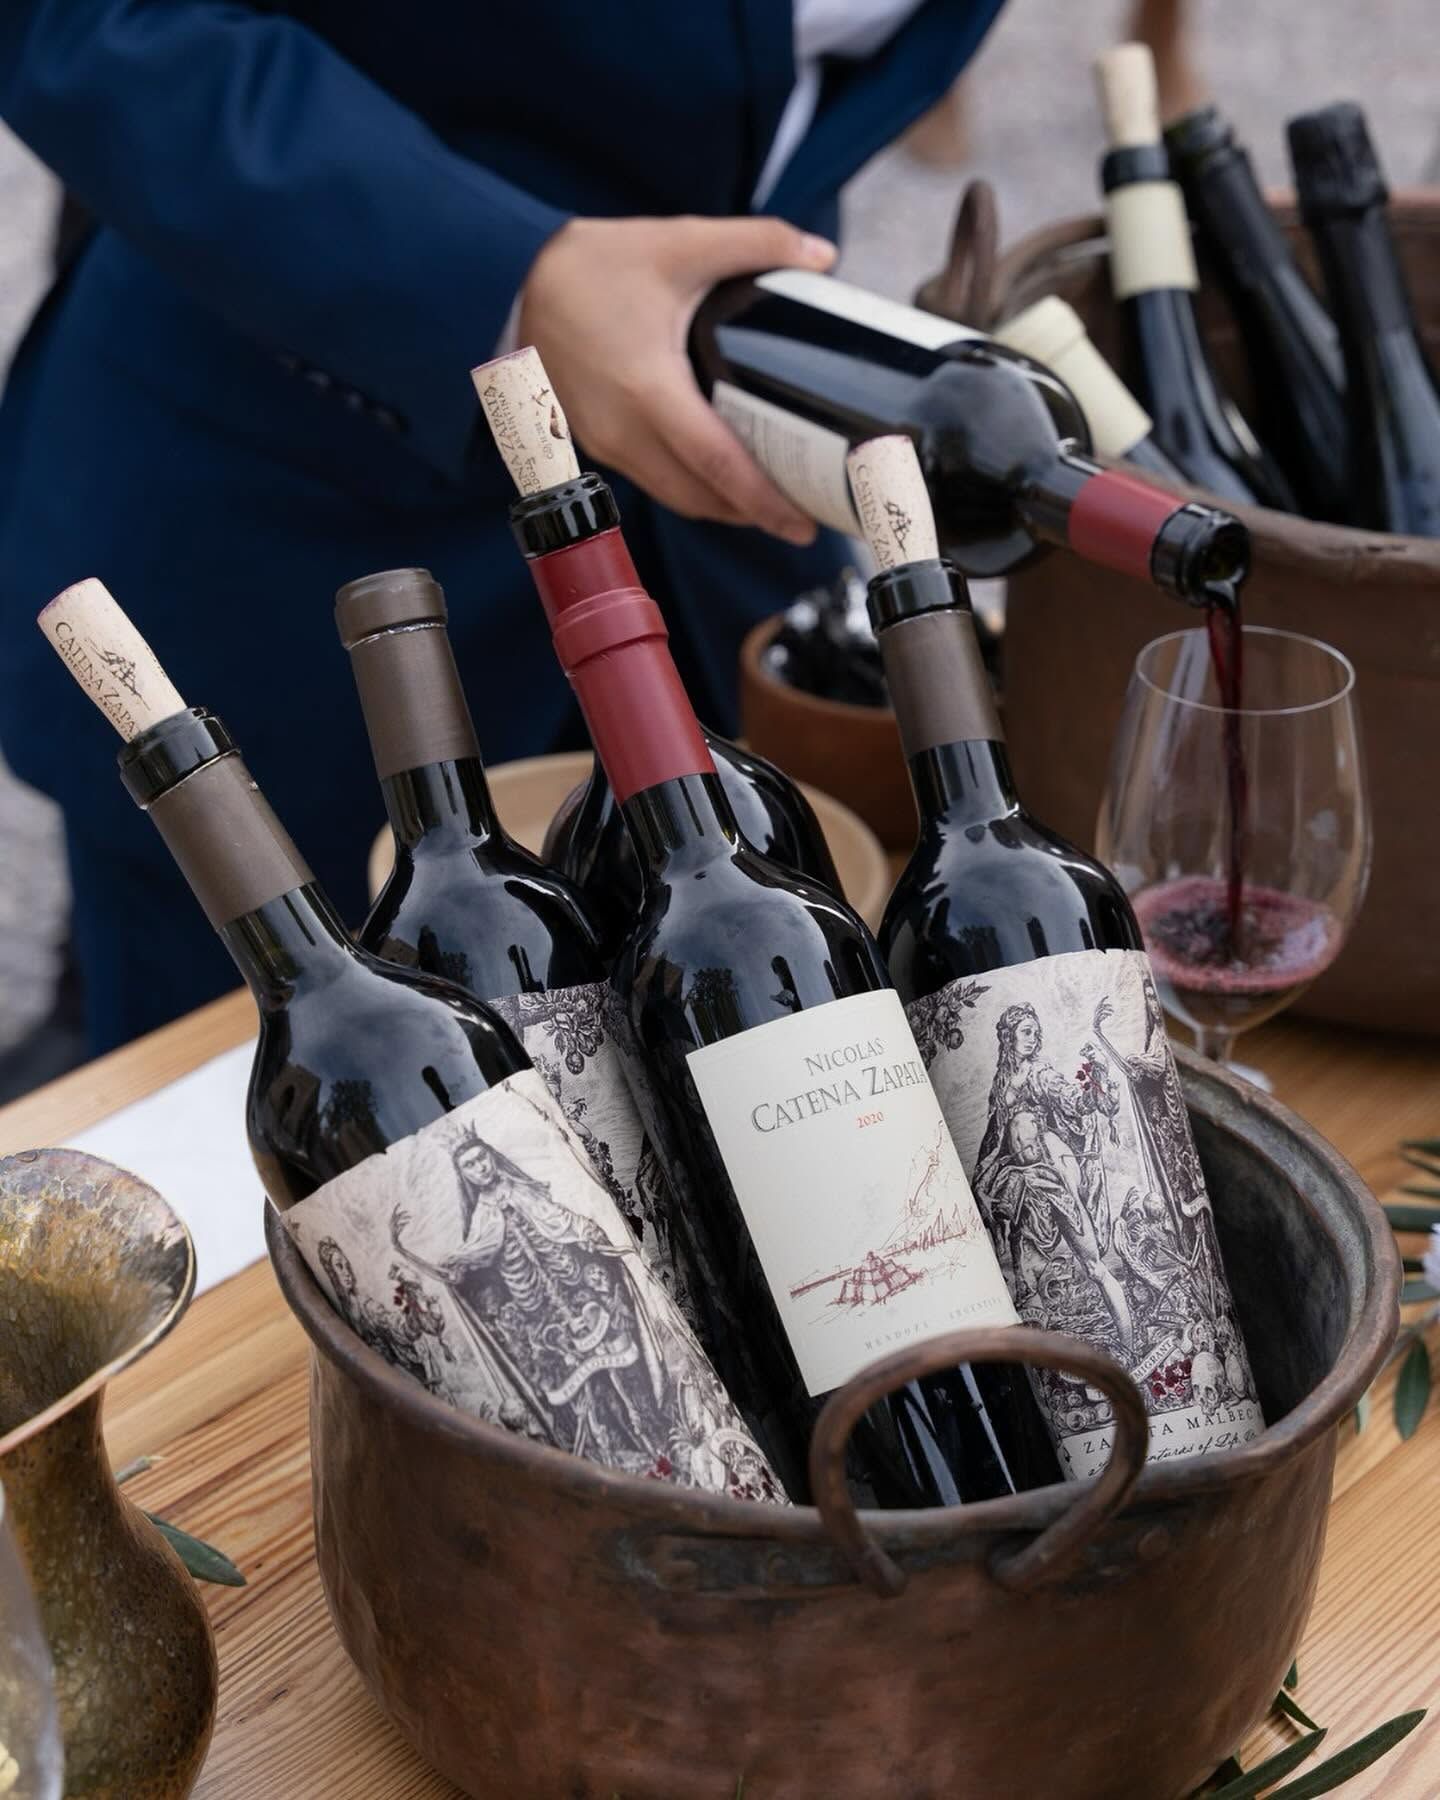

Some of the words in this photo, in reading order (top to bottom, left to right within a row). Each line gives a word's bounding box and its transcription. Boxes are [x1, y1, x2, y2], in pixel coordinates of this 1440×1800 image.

[56, 621, 104, 691] CATENA
[803, 1037, 886, 1077] NICOLAS
[751, 1078, 862, 1133] CATENA
[856, 1111, 884, 1129] 2020
[1133, 1338, 1173, 1380] MIGRANT
[1083, 1422, 1174, 1455] ZATA
[1186, 1407, 1256, 1431] MALBEC
